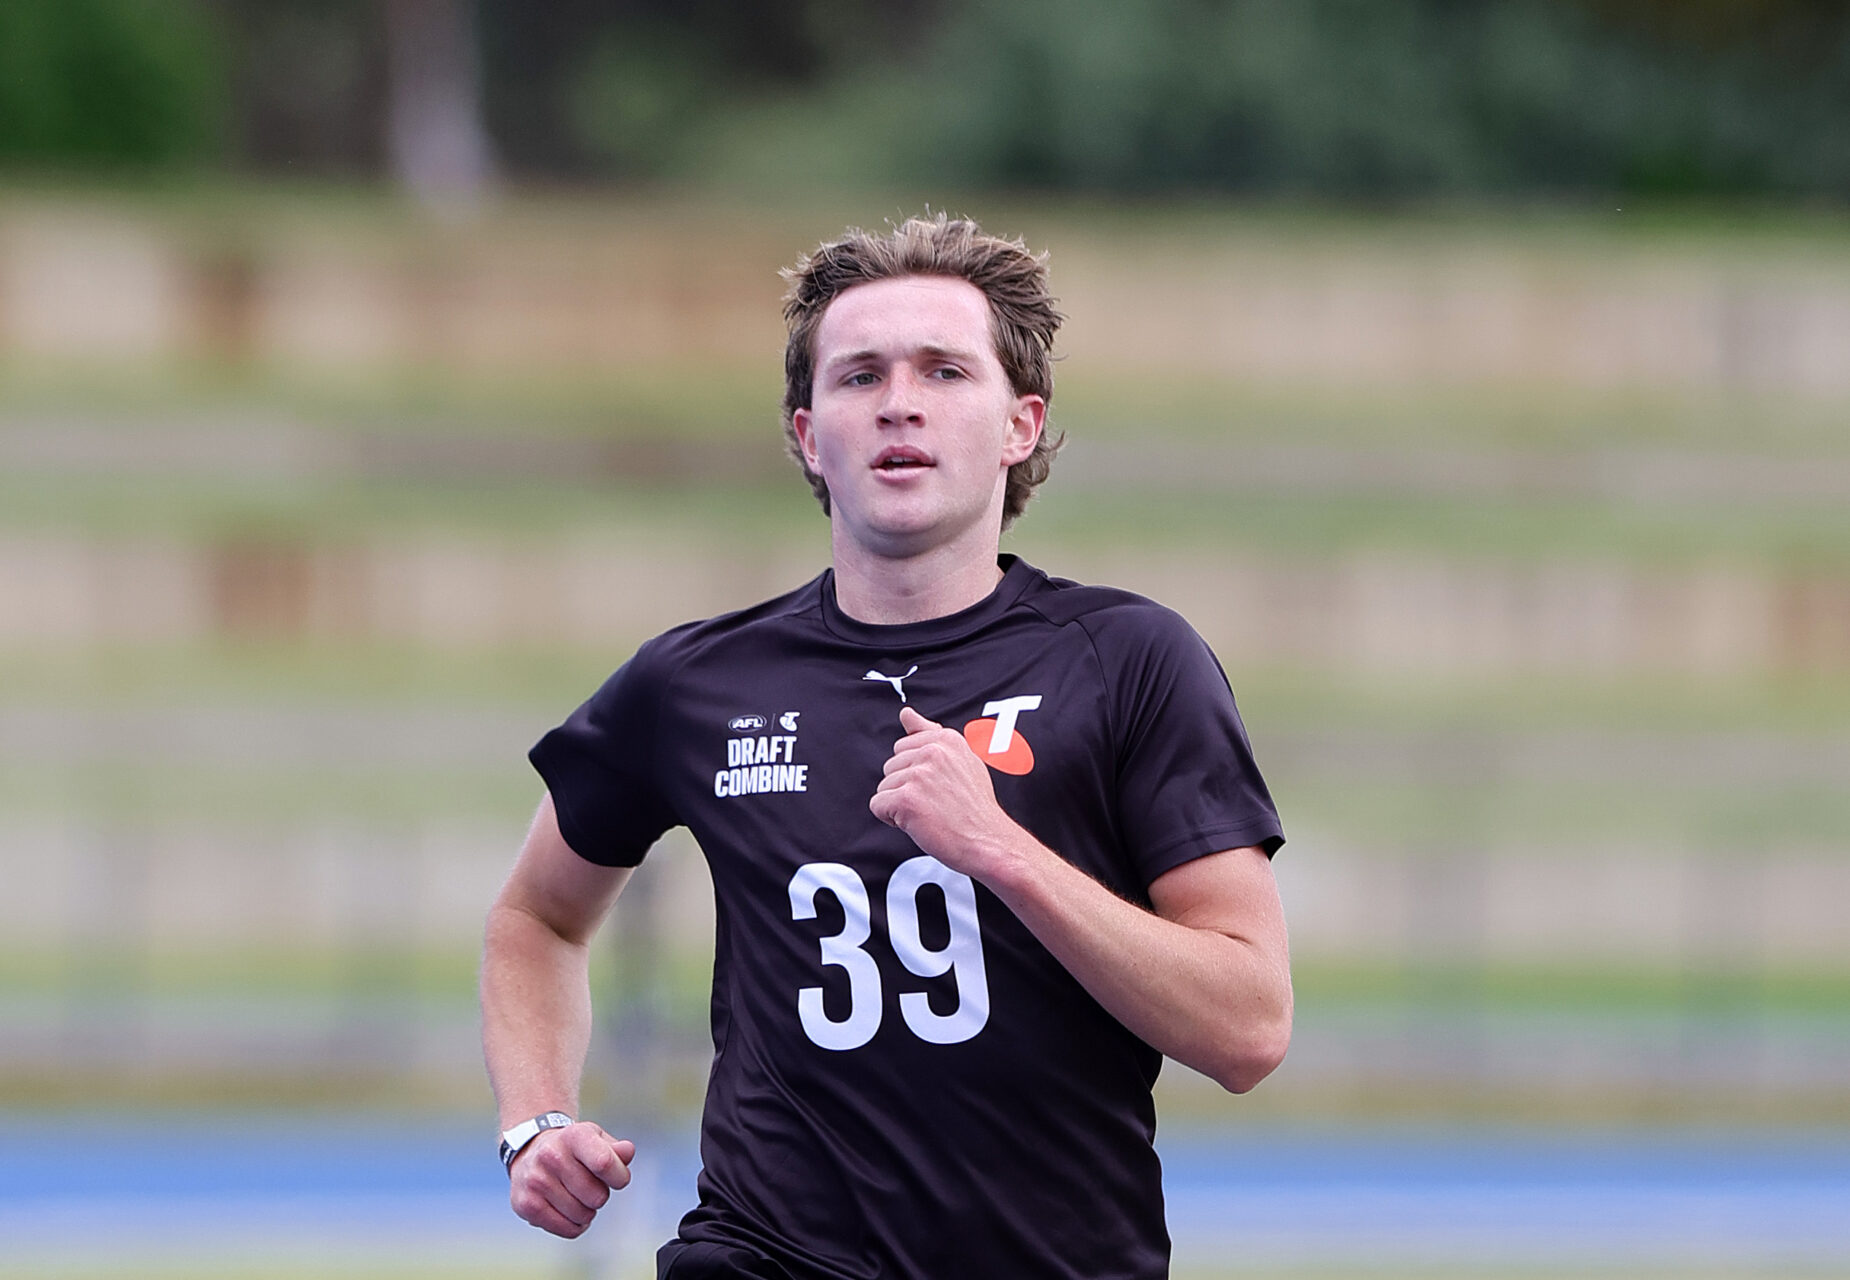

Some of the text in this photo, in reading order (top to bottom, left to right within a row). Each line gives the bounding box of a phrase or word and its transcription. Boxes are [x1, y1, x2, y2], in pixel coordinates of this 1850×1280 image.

[732, 718, 763, 729] AFL
[981, 695, 1042, 754] T
[727, 736, 797, 767] DRAFT
[714, 765, 808, 798] COMBINE
[788, 856, 990, 1051] 39
